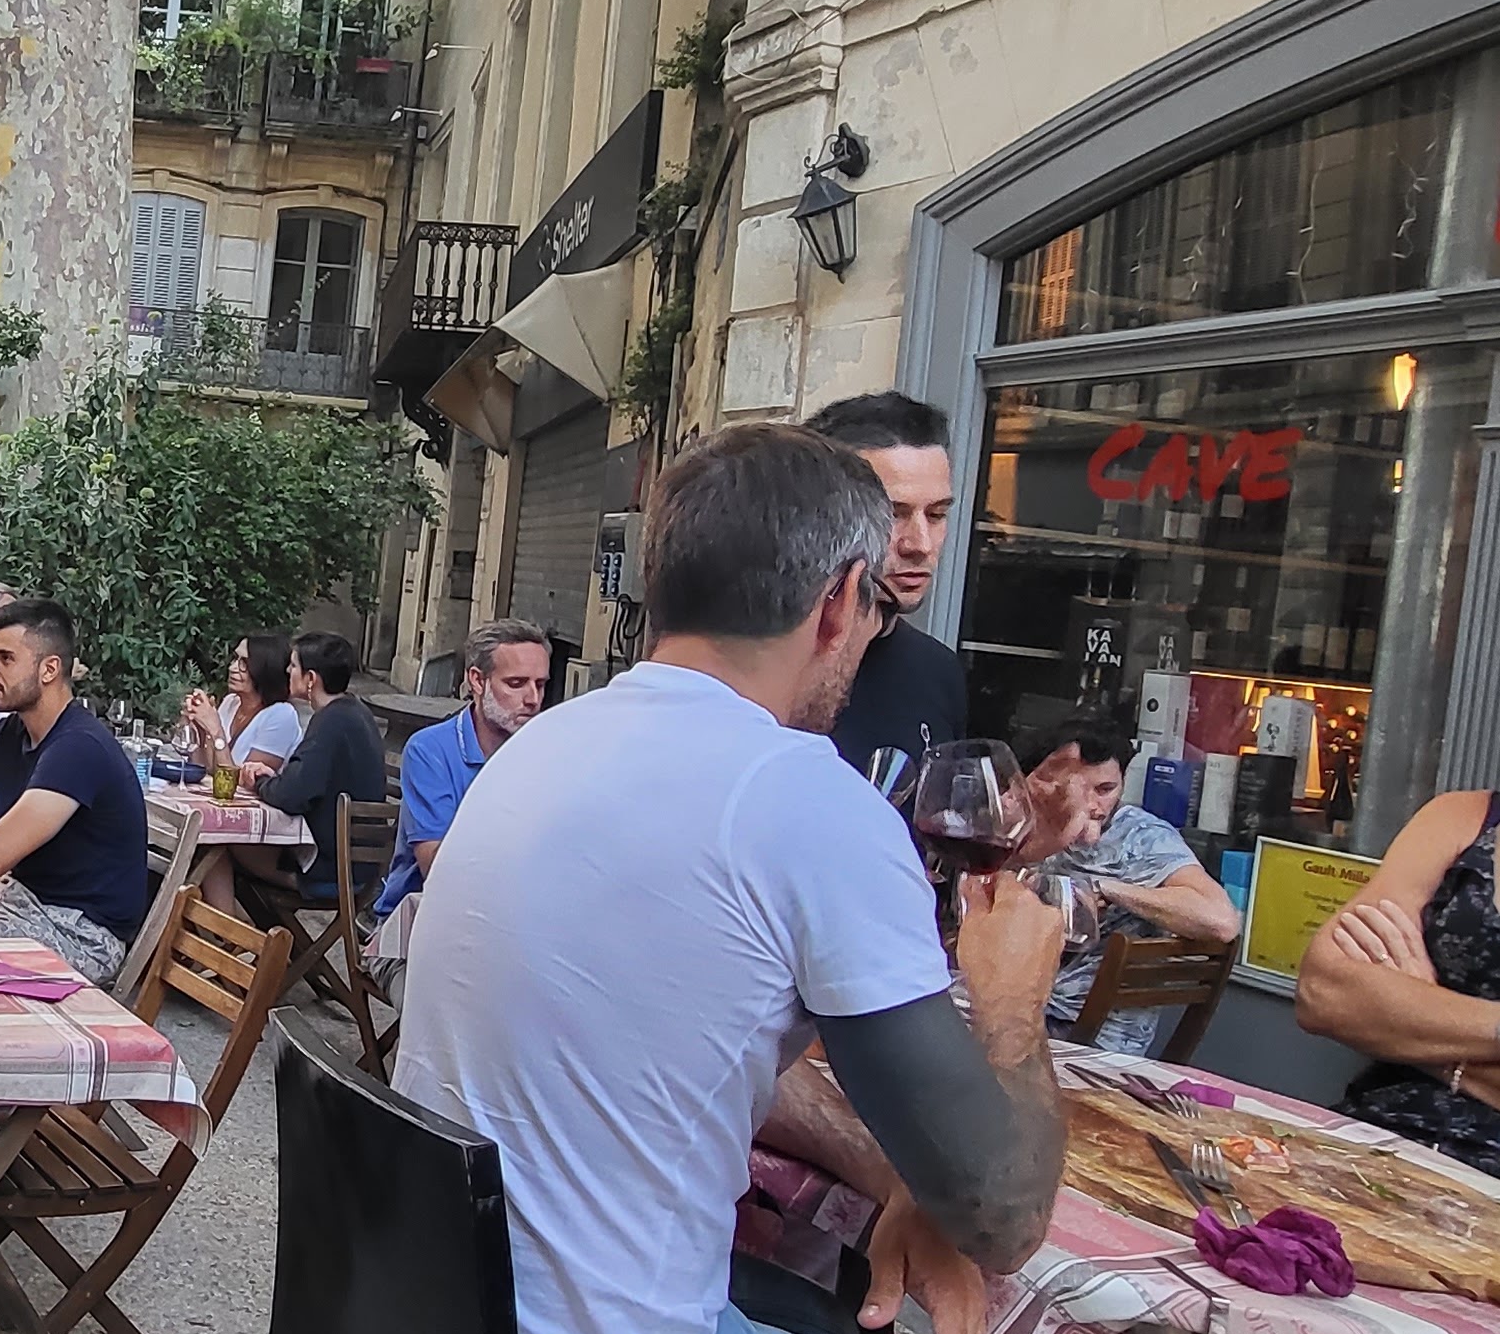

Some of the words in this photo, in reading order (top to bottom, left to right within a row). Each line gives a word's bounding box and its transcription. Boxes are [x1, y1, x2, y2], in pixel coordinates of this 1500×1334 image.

[550, 195, 595, 271] Shelter
[1086, 422, 1303, 501] CAVE
[1086, 641, 1110, 654] VA
[1087, 628, 1112, 642] KA
